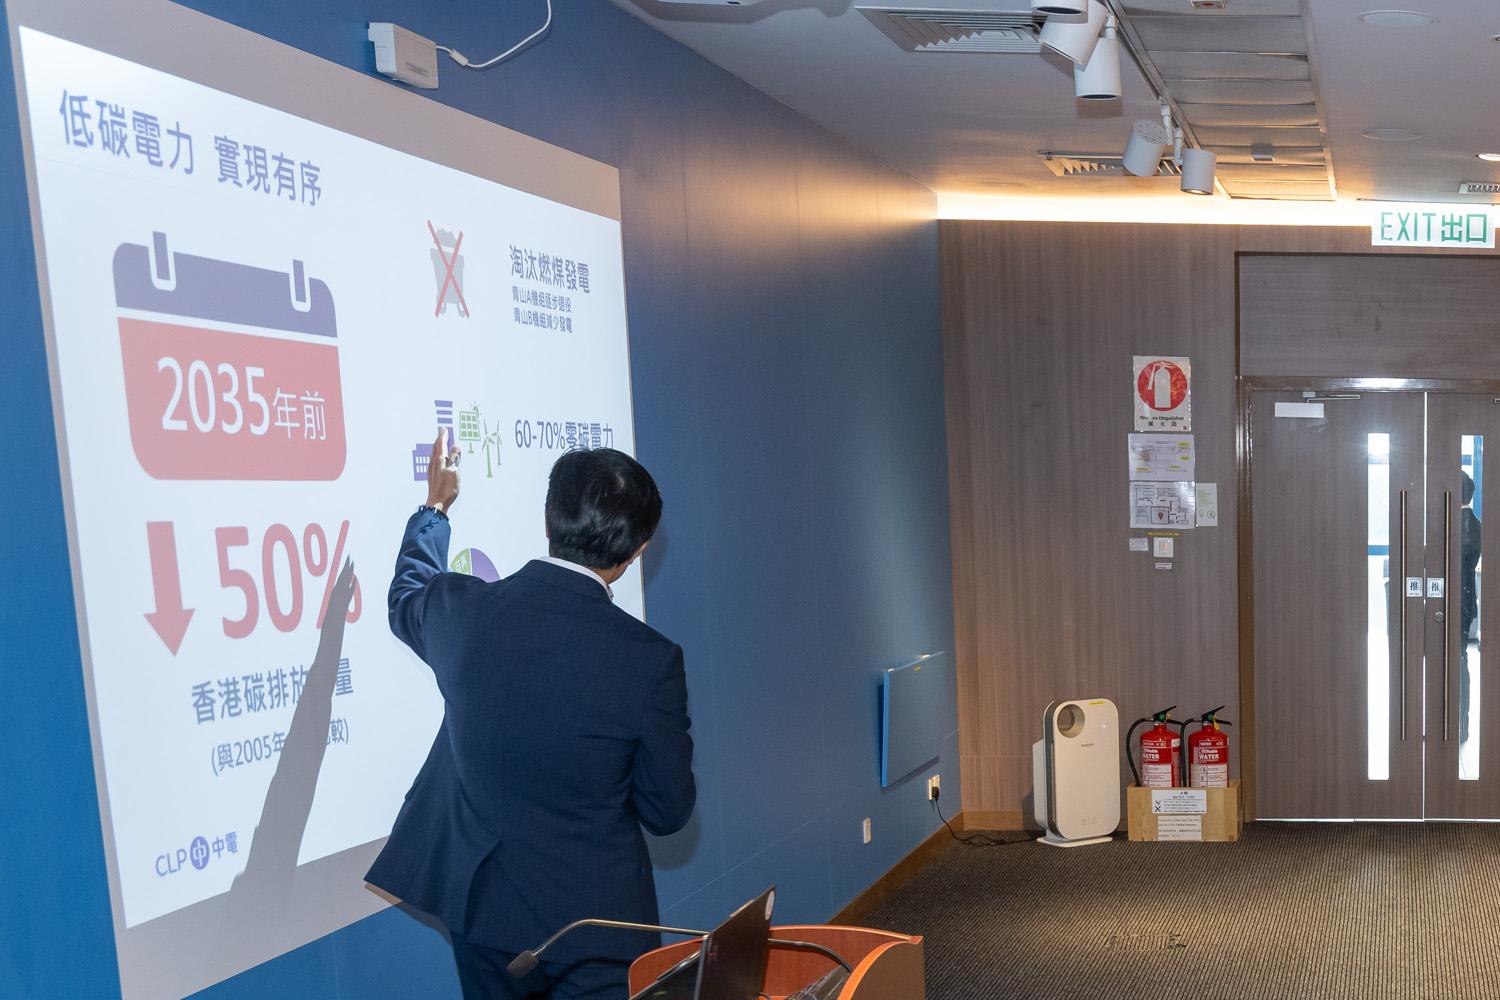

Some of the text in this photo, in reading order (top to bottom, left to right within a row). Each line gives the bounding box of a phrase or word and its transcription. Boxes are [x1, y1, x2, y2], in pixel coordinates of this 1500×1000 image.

[59, 89, 322, 207] 低碳電力 實現有序
[1380, 212, 1487, 243] EXIT 出口
[509, 243, 590, 293] 淘汰燃煤發電
[157, 356, 328, 441] 2035年前
[515, 420, 614, 450] 60-70%零碳電力
[215, 519, 362, 639] 50%
[192, 658, 354, 724] 香港碳排放量
[211, 717, 349, 776] (與2005年較)
[155, 848, 188, 877] CLP
